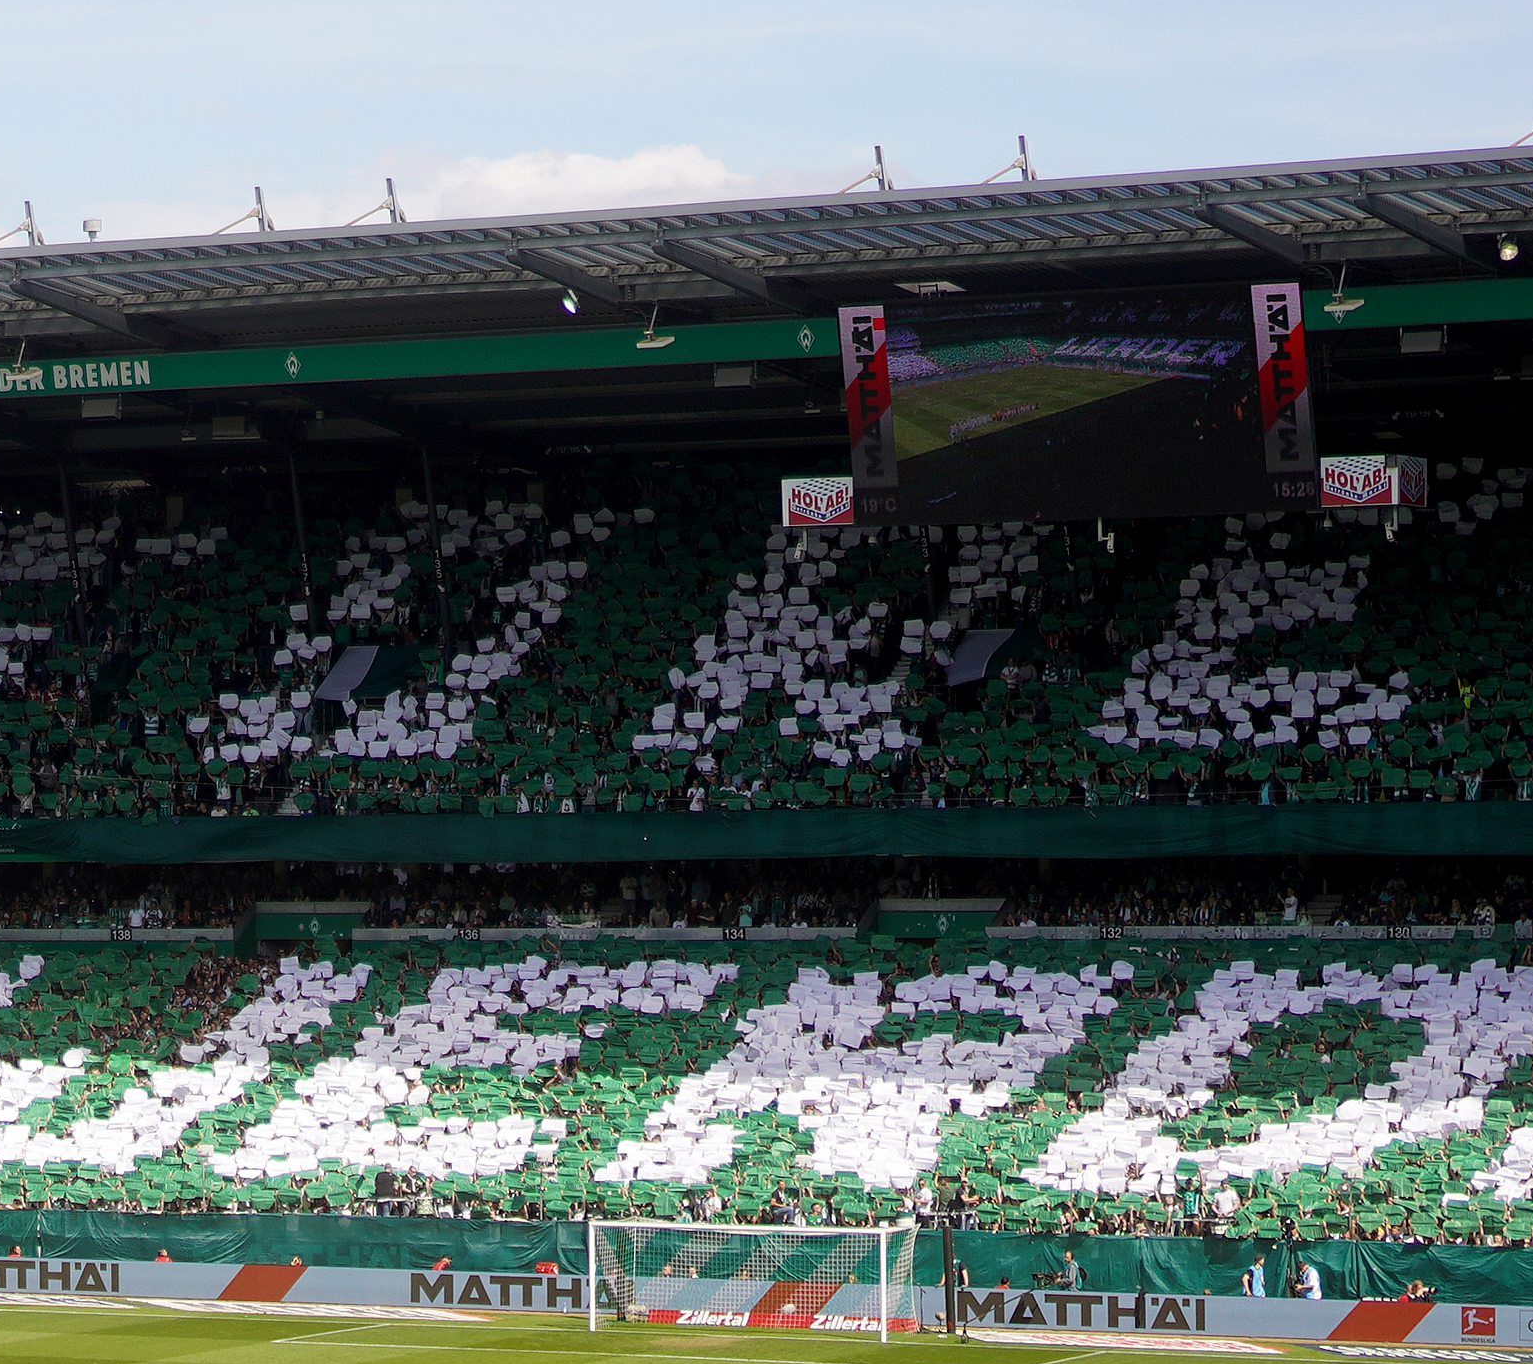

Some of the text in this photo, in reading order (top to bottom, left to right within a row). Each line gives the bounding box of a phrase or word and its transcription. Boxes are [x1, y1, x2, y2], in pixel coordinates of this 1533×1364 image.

[52, 359, 152, 390] BREMEN
[1265, 292, 1301, 462] MATTHÄI
[851, 314, 888, 479] MATTHÄI
[920, 527, 930, 558] 133
[1062, 525, 1071, 557] 131
[71, 560, 79, 589] 139
[300, 552, 309, 582] 137
[434, 548, 443, 580] 135
[112, 929, 132, 941] 138
[459, 928, 479, 940] 136
[724, 928, 745, 940] 134
[1100, 926, 1122, 939] 132
[1388, 927, 1411, 939] 130
[676, 1310, 749, 1327] Zillertal
[810, 1315, 882, 1332] Zillerta
[957, 1288, 1207, 1332] MATTHÄI
